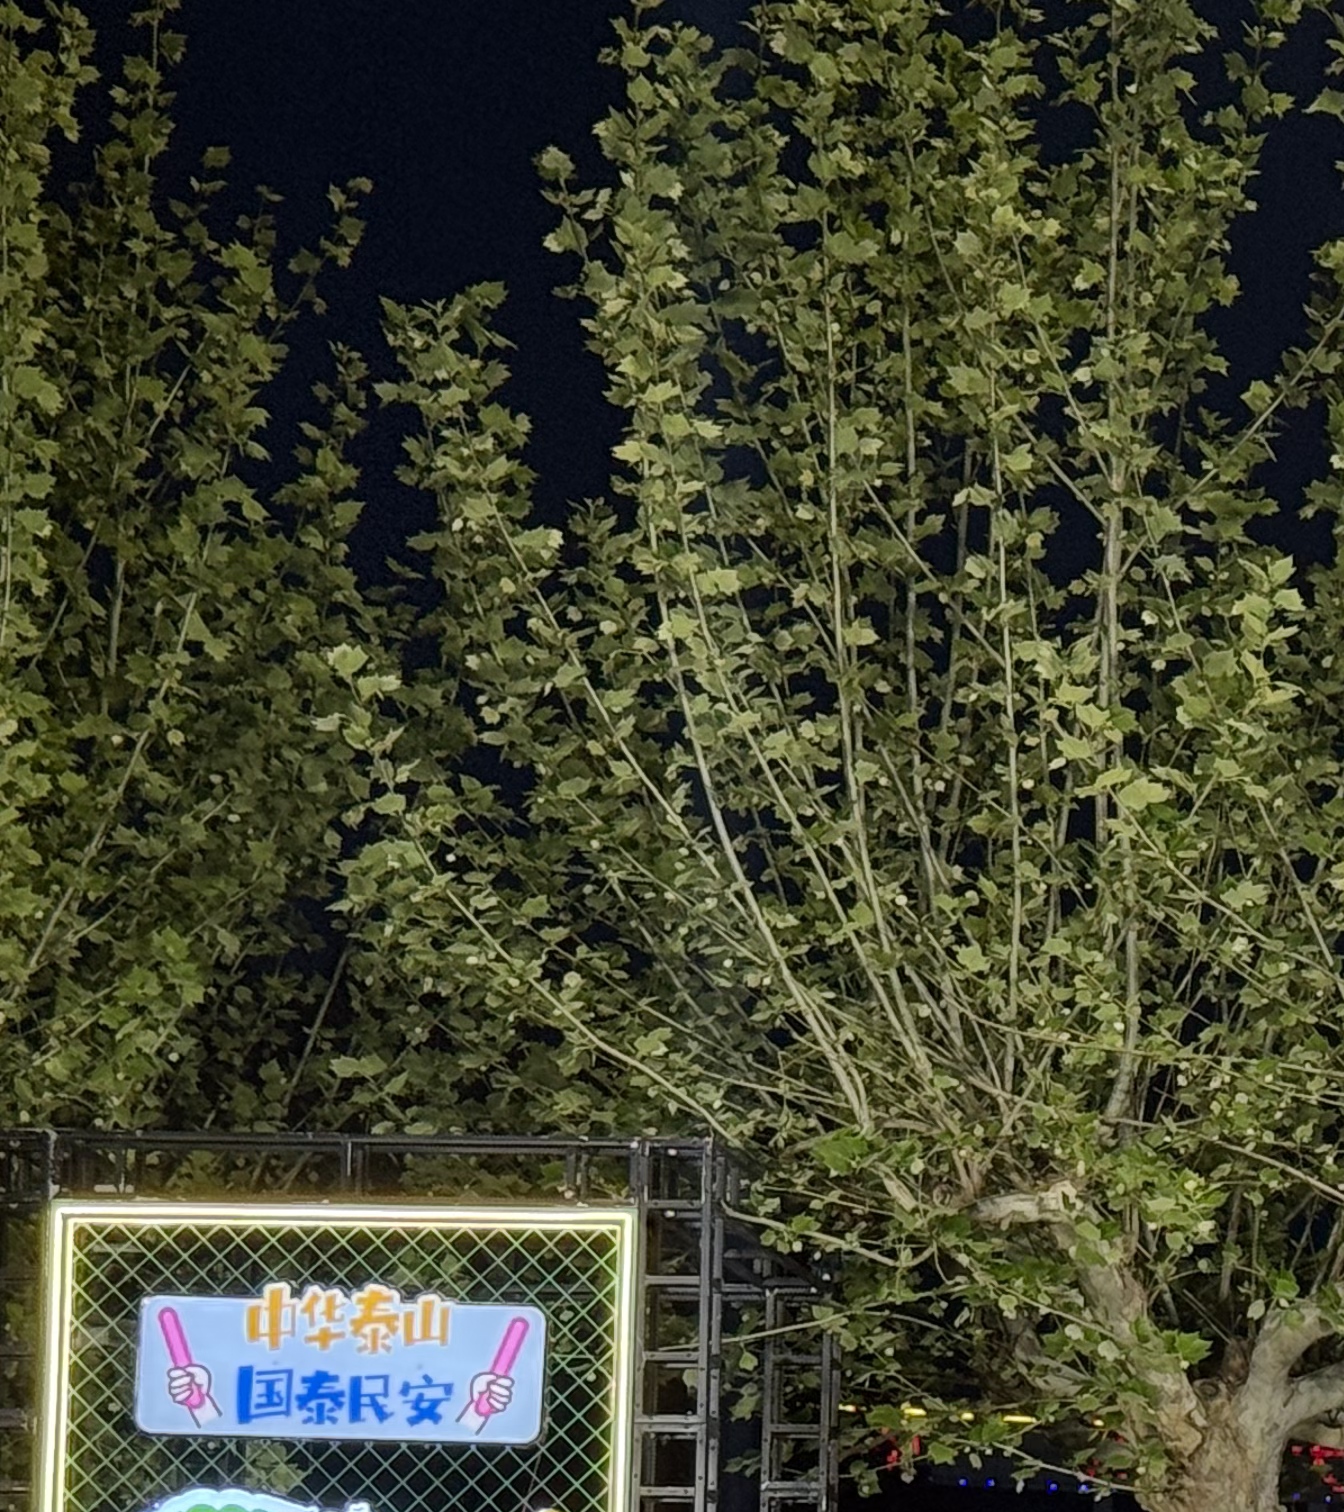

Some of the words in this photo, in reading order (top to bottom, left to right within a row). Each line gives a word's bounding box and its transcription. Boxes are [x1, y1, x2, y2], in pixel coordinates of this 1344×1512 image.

[245, 1286, 451, 1353] 中华泰山
[237, 1366, 453, 1426] 国泰民安
